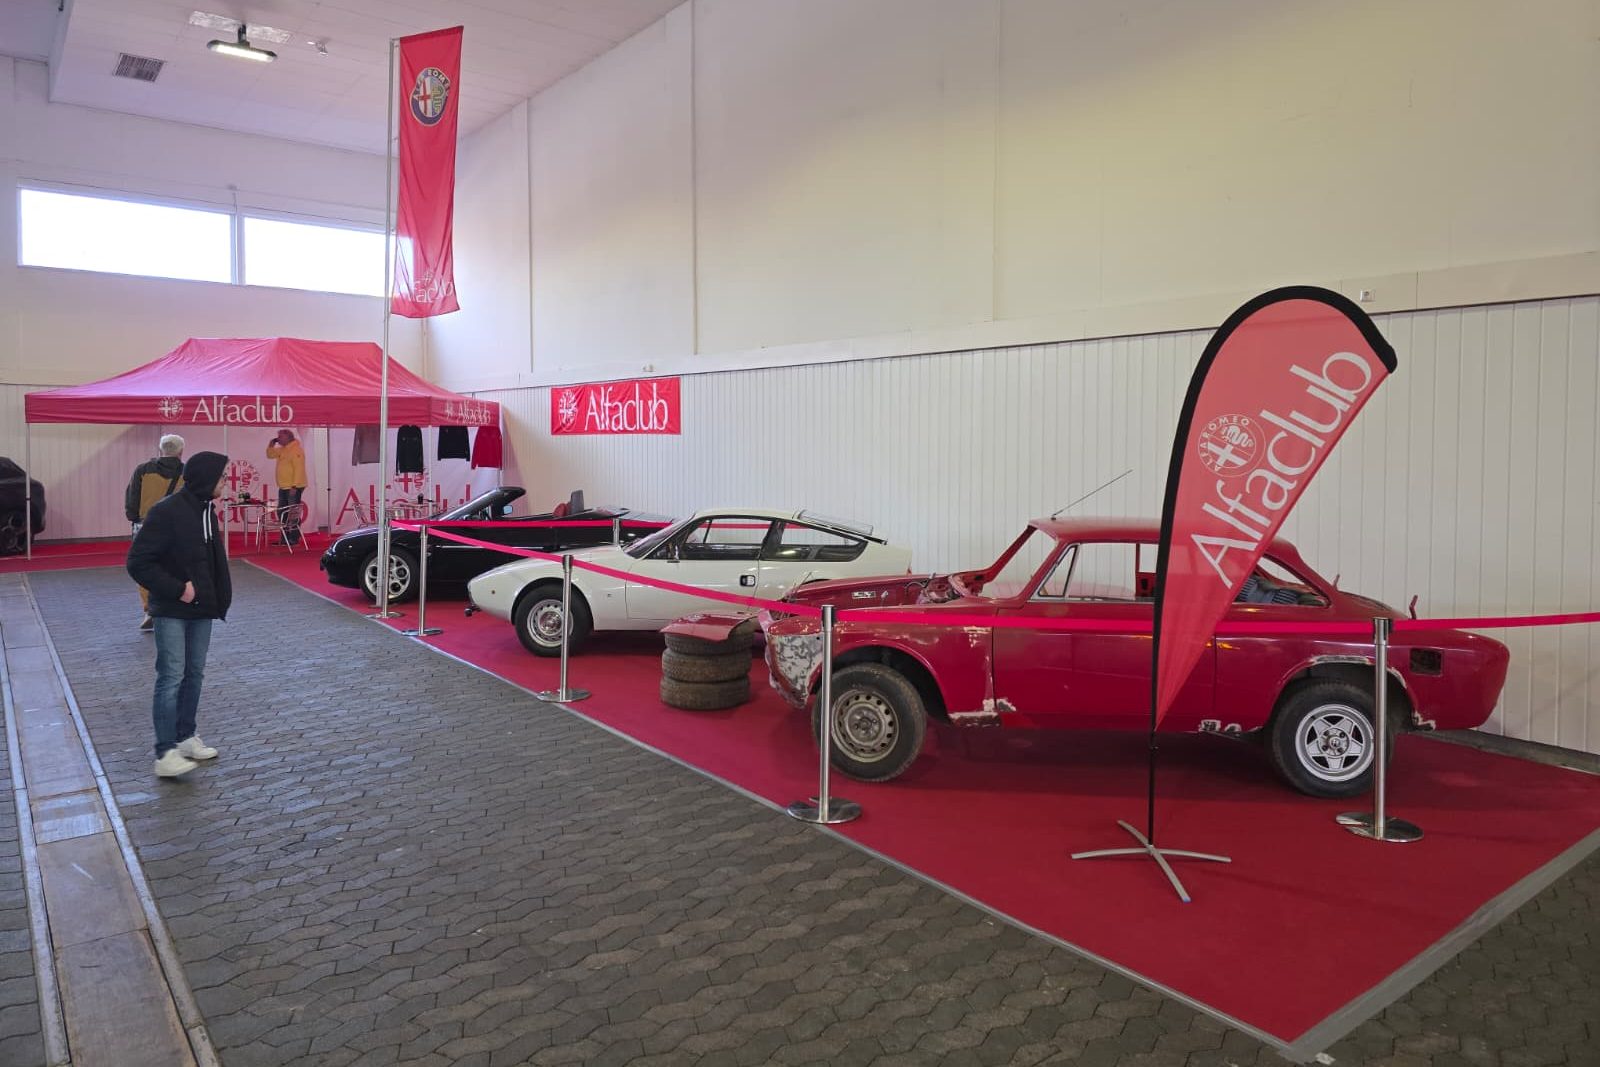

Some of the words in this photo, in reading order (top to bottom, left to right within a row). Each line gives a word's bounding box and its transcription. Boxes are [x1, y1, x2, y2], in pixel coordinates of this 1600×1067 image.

[192, 395, 294, 423] Alfaclub
[585, 382, 669, 431] Alfaclub
[1202, 415, 1250, 439] ROMEO
[1191, 351, 1372, 589] Alfaclub
